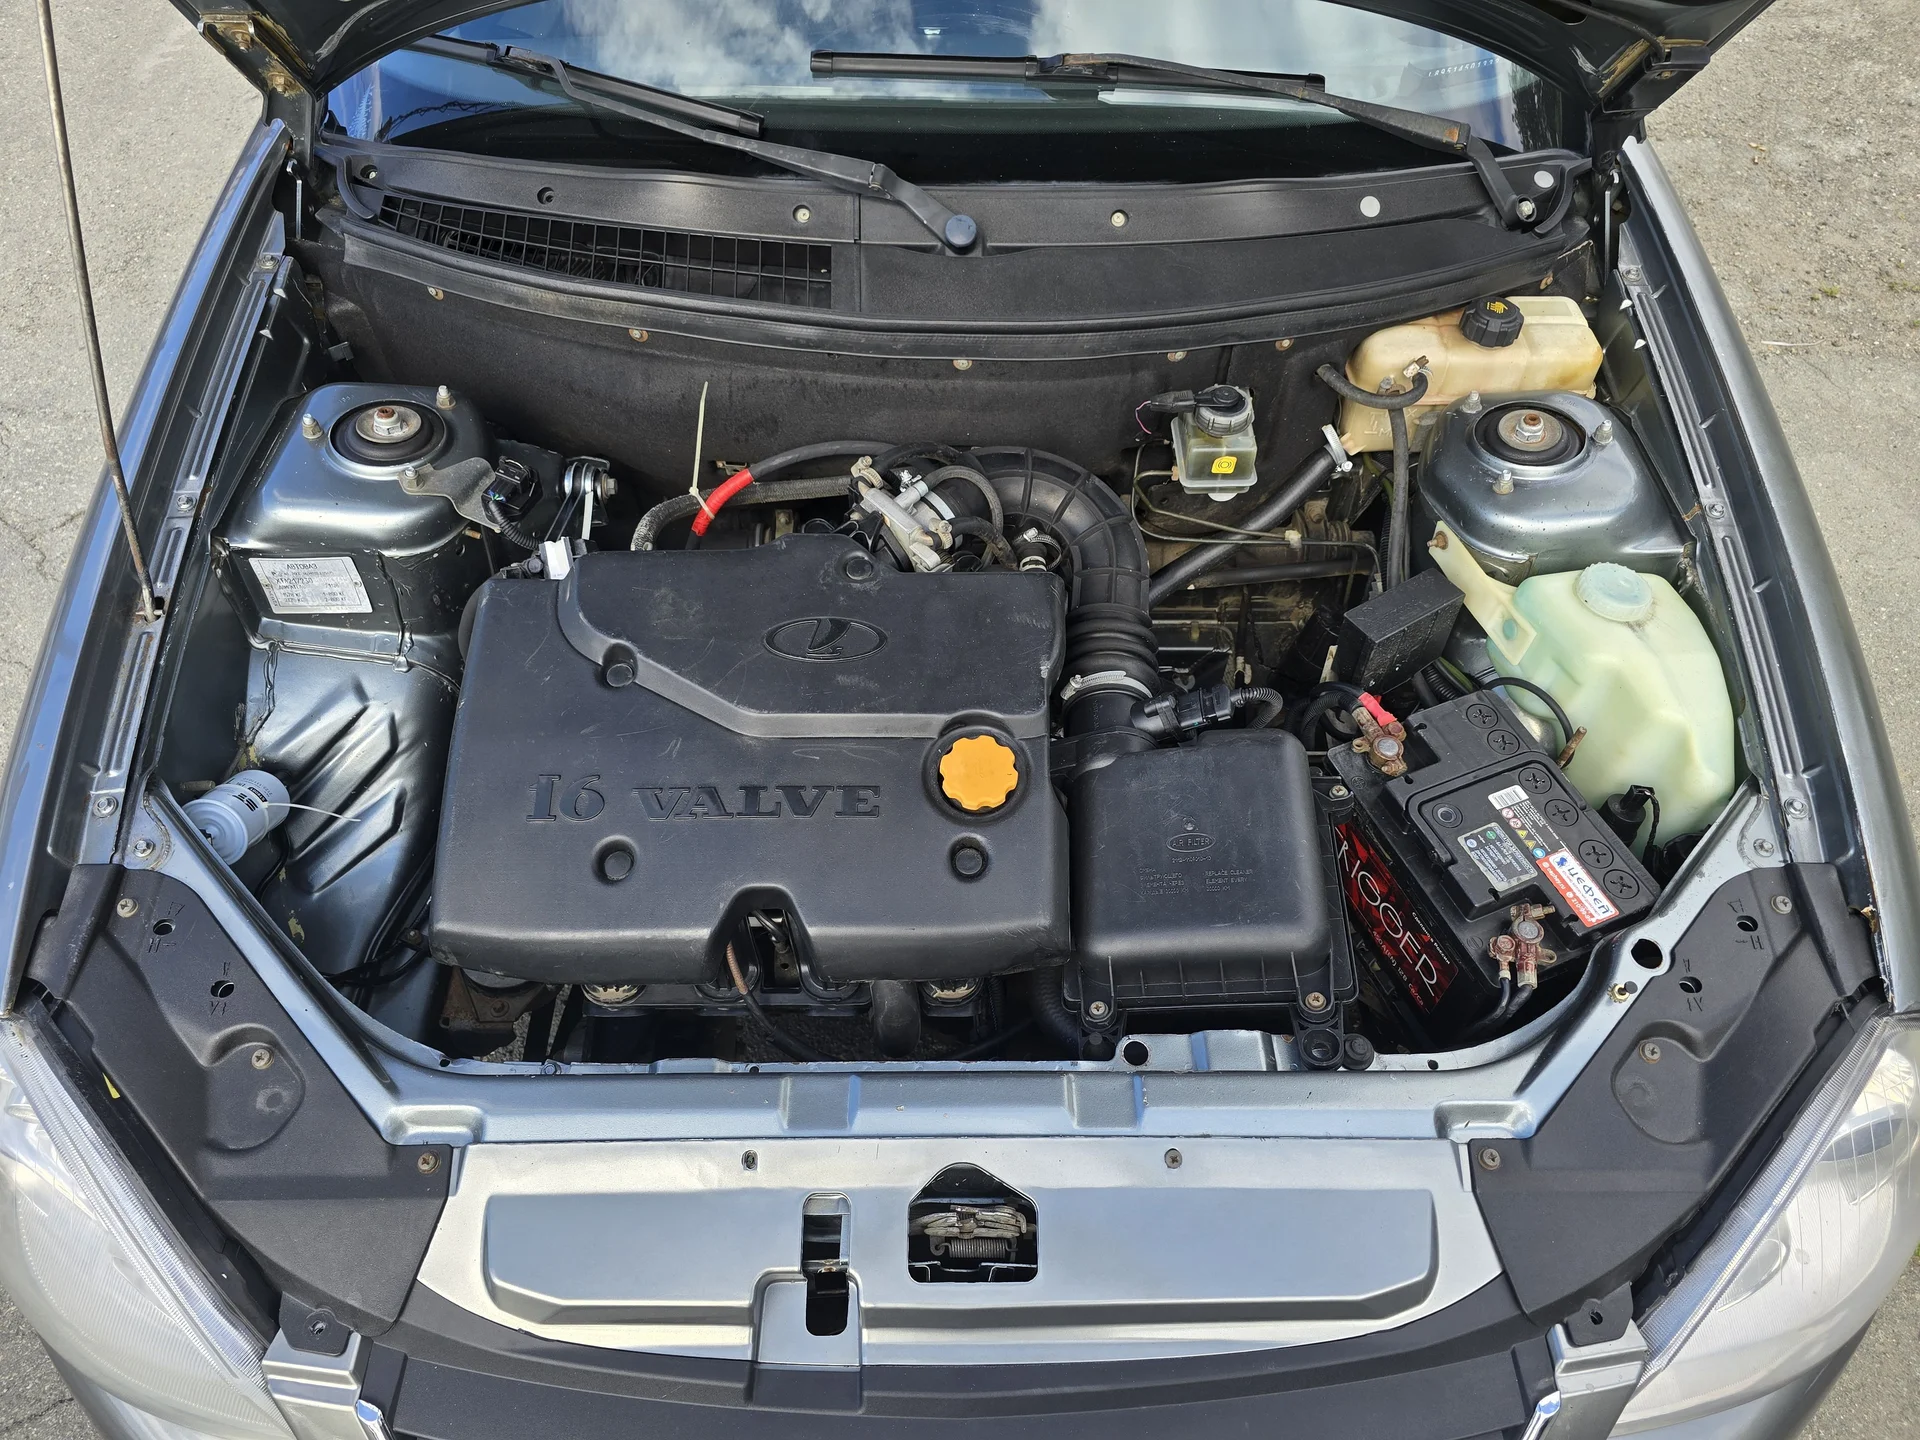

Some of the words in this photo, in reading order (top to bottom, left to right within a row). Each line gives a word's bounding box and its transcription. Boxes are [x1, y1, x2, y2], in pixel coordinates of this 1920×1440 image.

[526, 773, 605, 822] 16
[632, 785, 881, 821] VALVE
[1187, 837, 1210, 847] FILTER
[1567, 867, 1610, 915] ЦЕФЕЙ
[1411, 911, 1432, 939] Сделано
[1433, 941, 1451, 965] России
